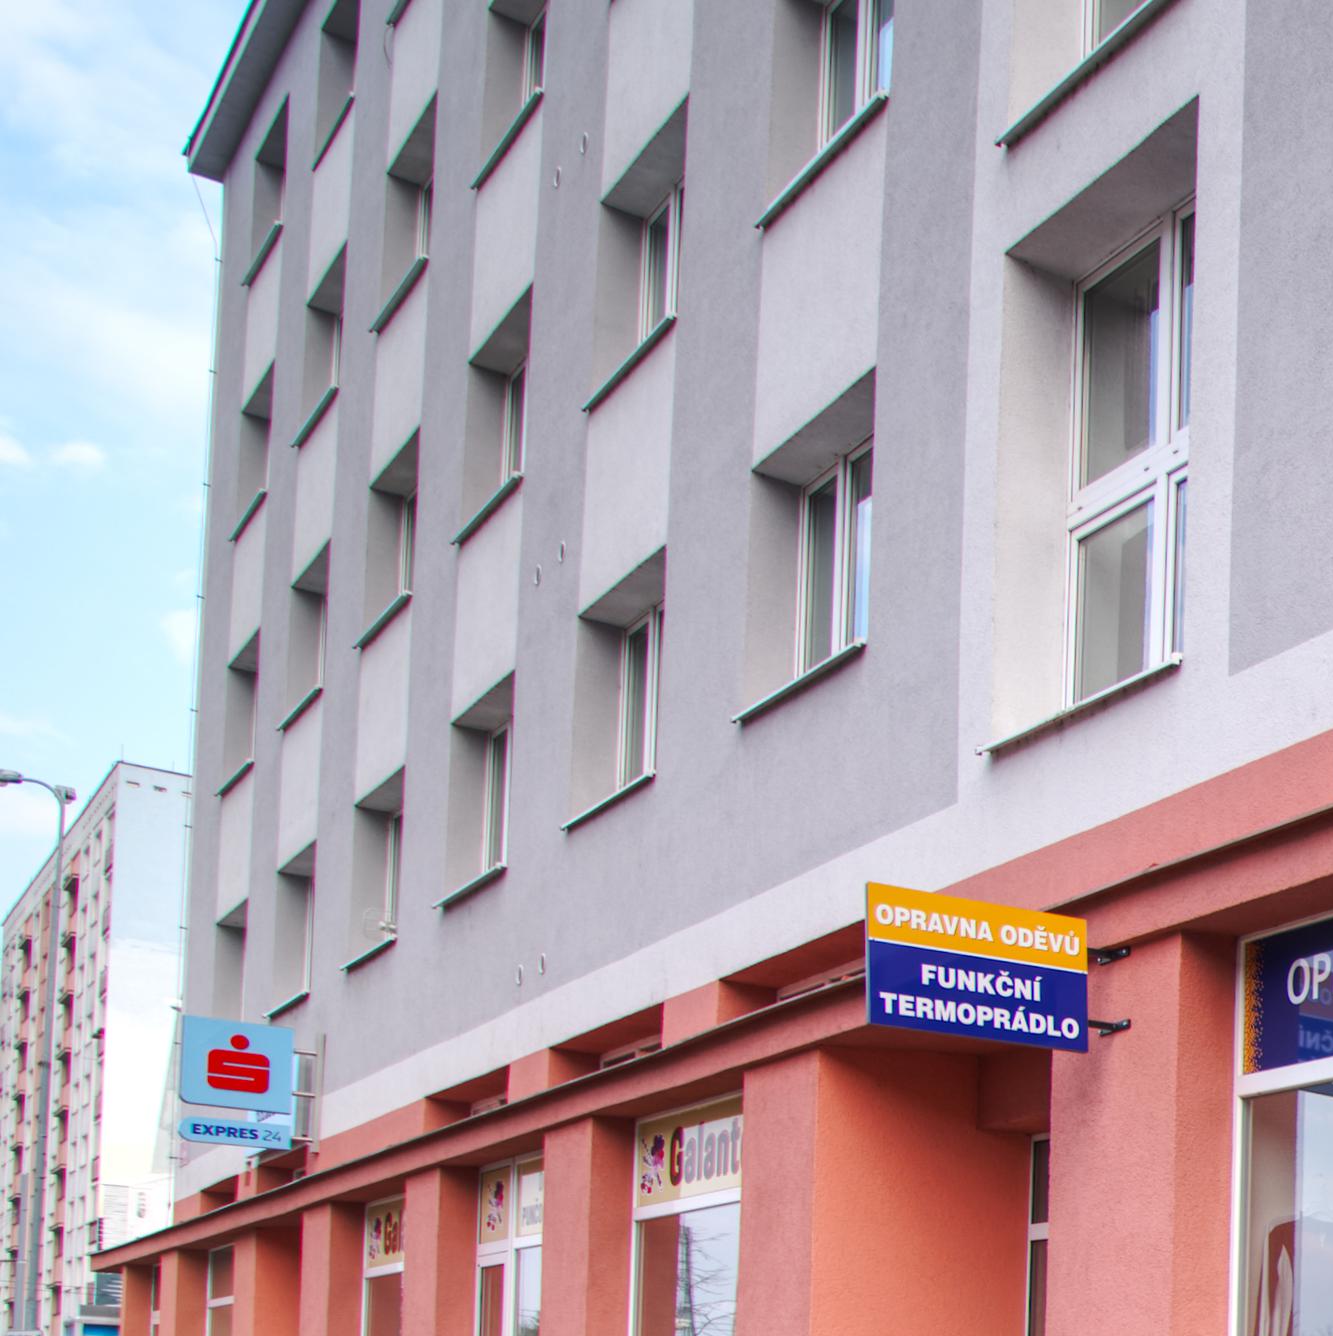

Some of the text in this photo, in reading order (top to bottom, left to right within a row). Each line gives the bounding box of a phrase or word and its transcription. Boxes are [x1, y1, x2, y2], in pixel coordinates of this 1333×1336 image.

[876, 904, 1080, 956] OPRAVNA ODĚVŮ
[921, 964, 1042, 1001] FUNKČNÍ
[879, 991, 1080, 1039] TERMOPRÁDLO
[192, 1123, 282, 1142] EXPRES 24
